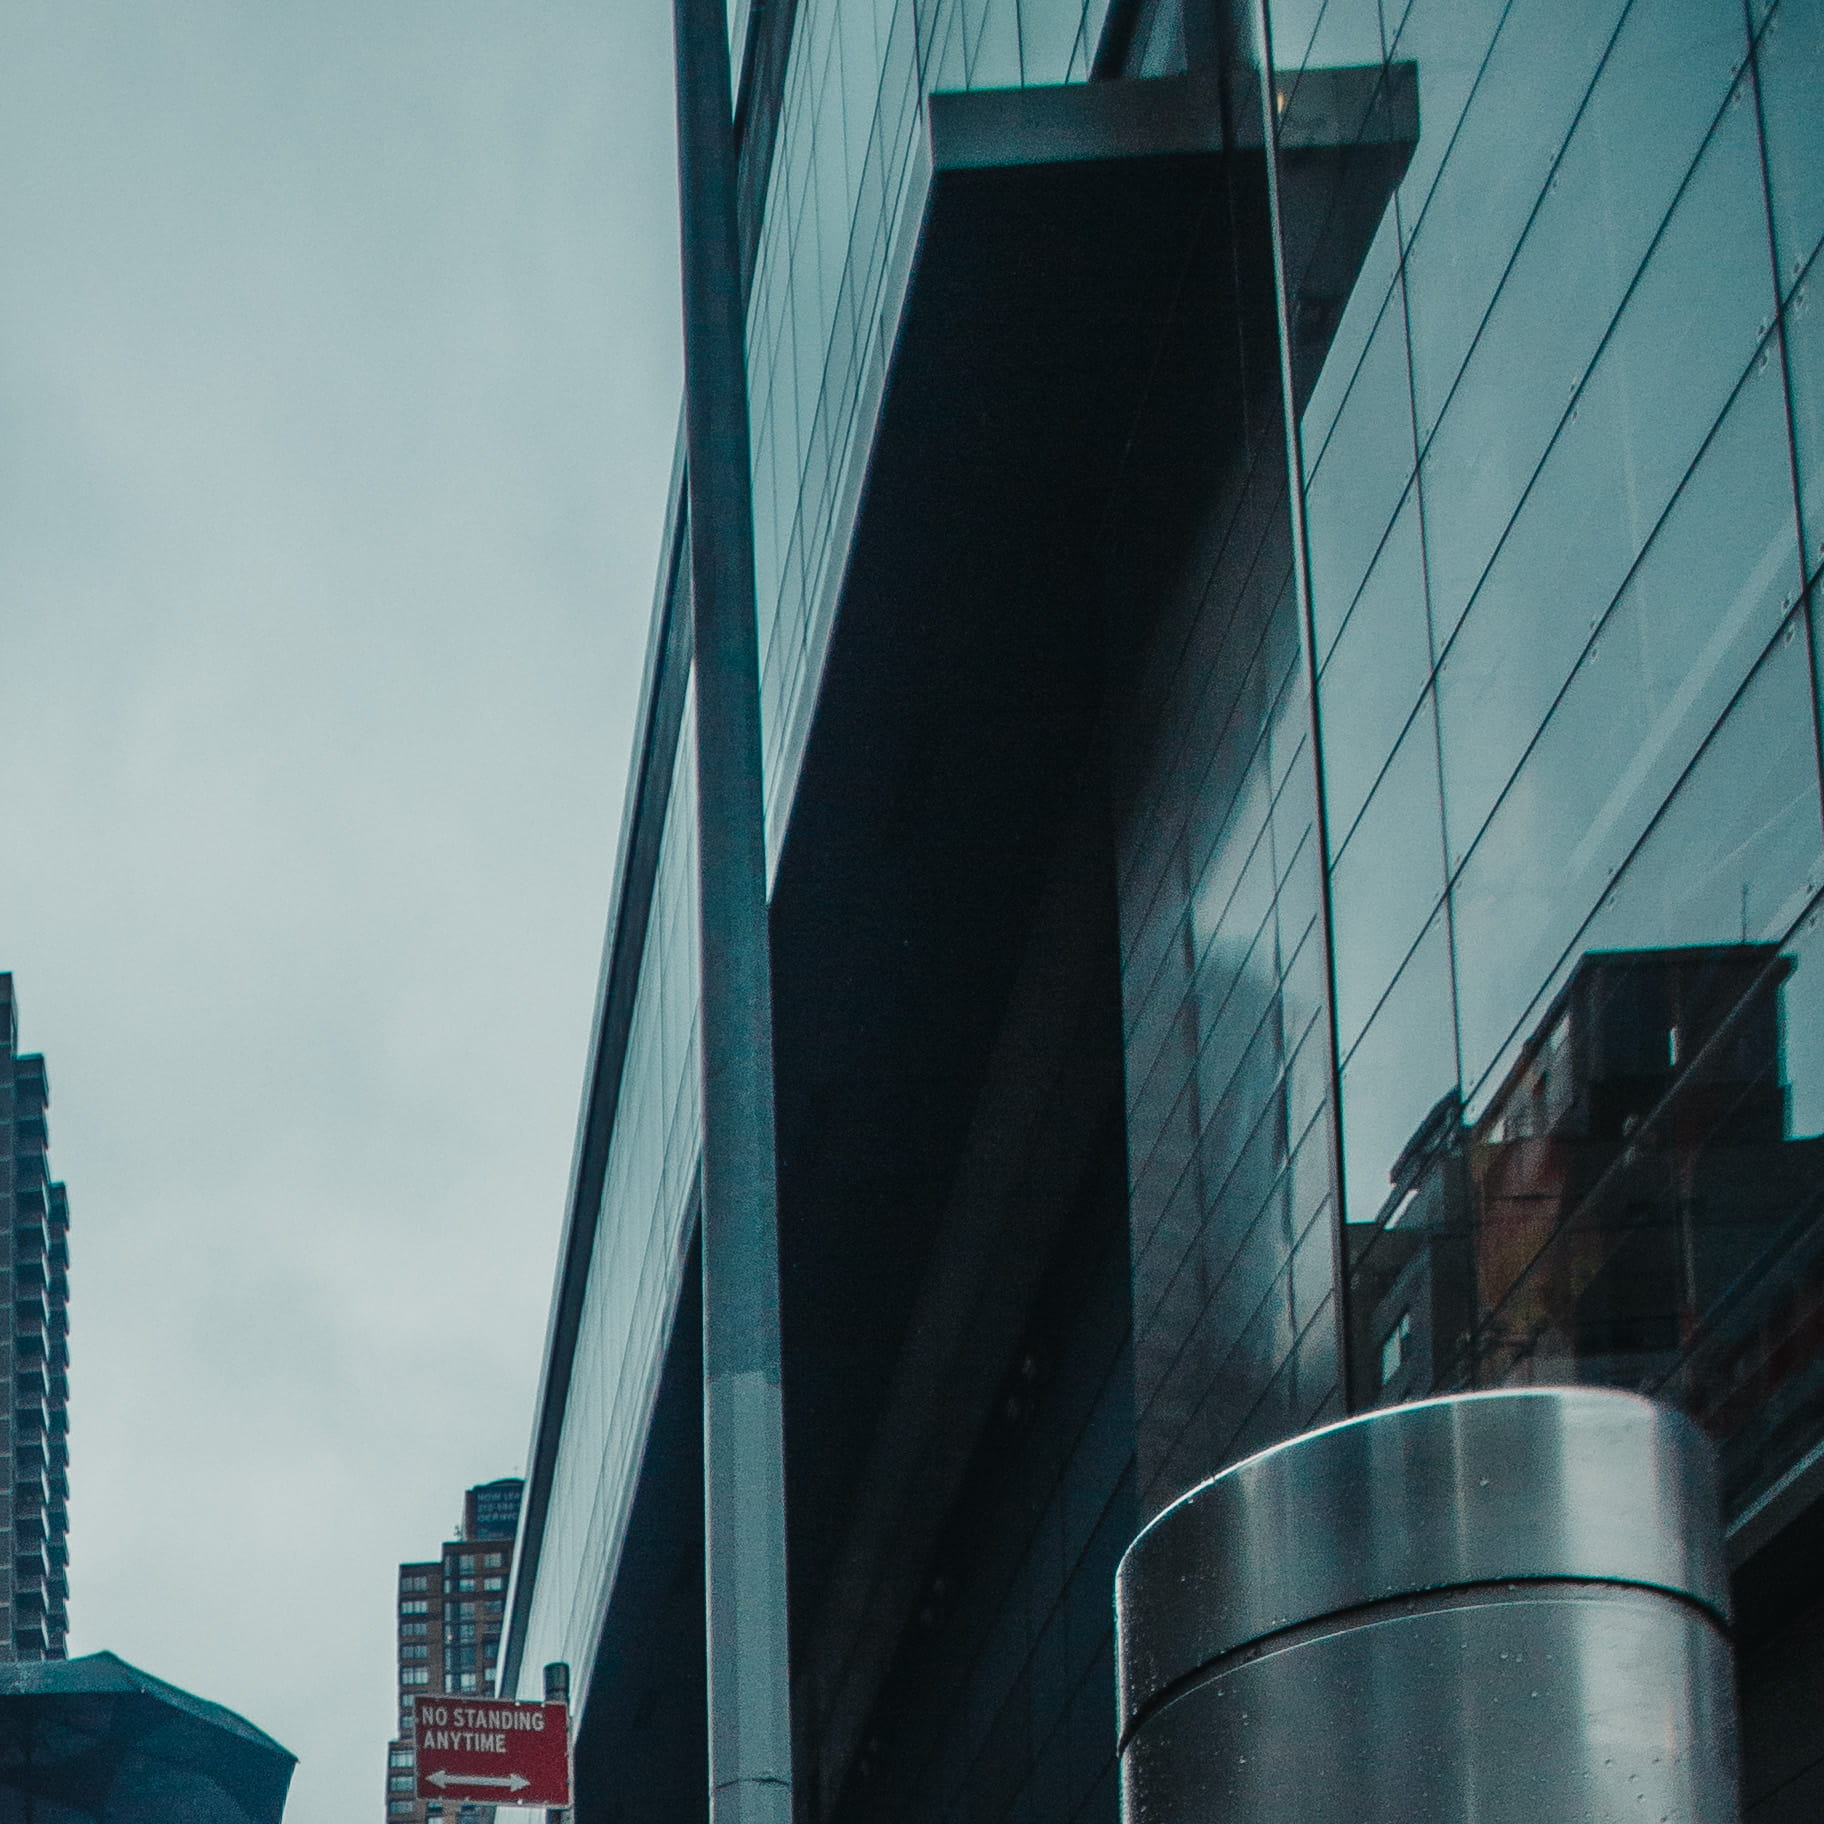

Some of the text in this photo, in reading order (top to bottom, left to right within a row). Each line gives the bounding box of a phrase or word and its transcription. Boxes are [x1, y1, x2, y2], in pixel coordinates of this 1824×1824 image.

[422, 1707, 545, 1732] NO STANDING
[424, 1730, 507, 1753] ANYTIME
